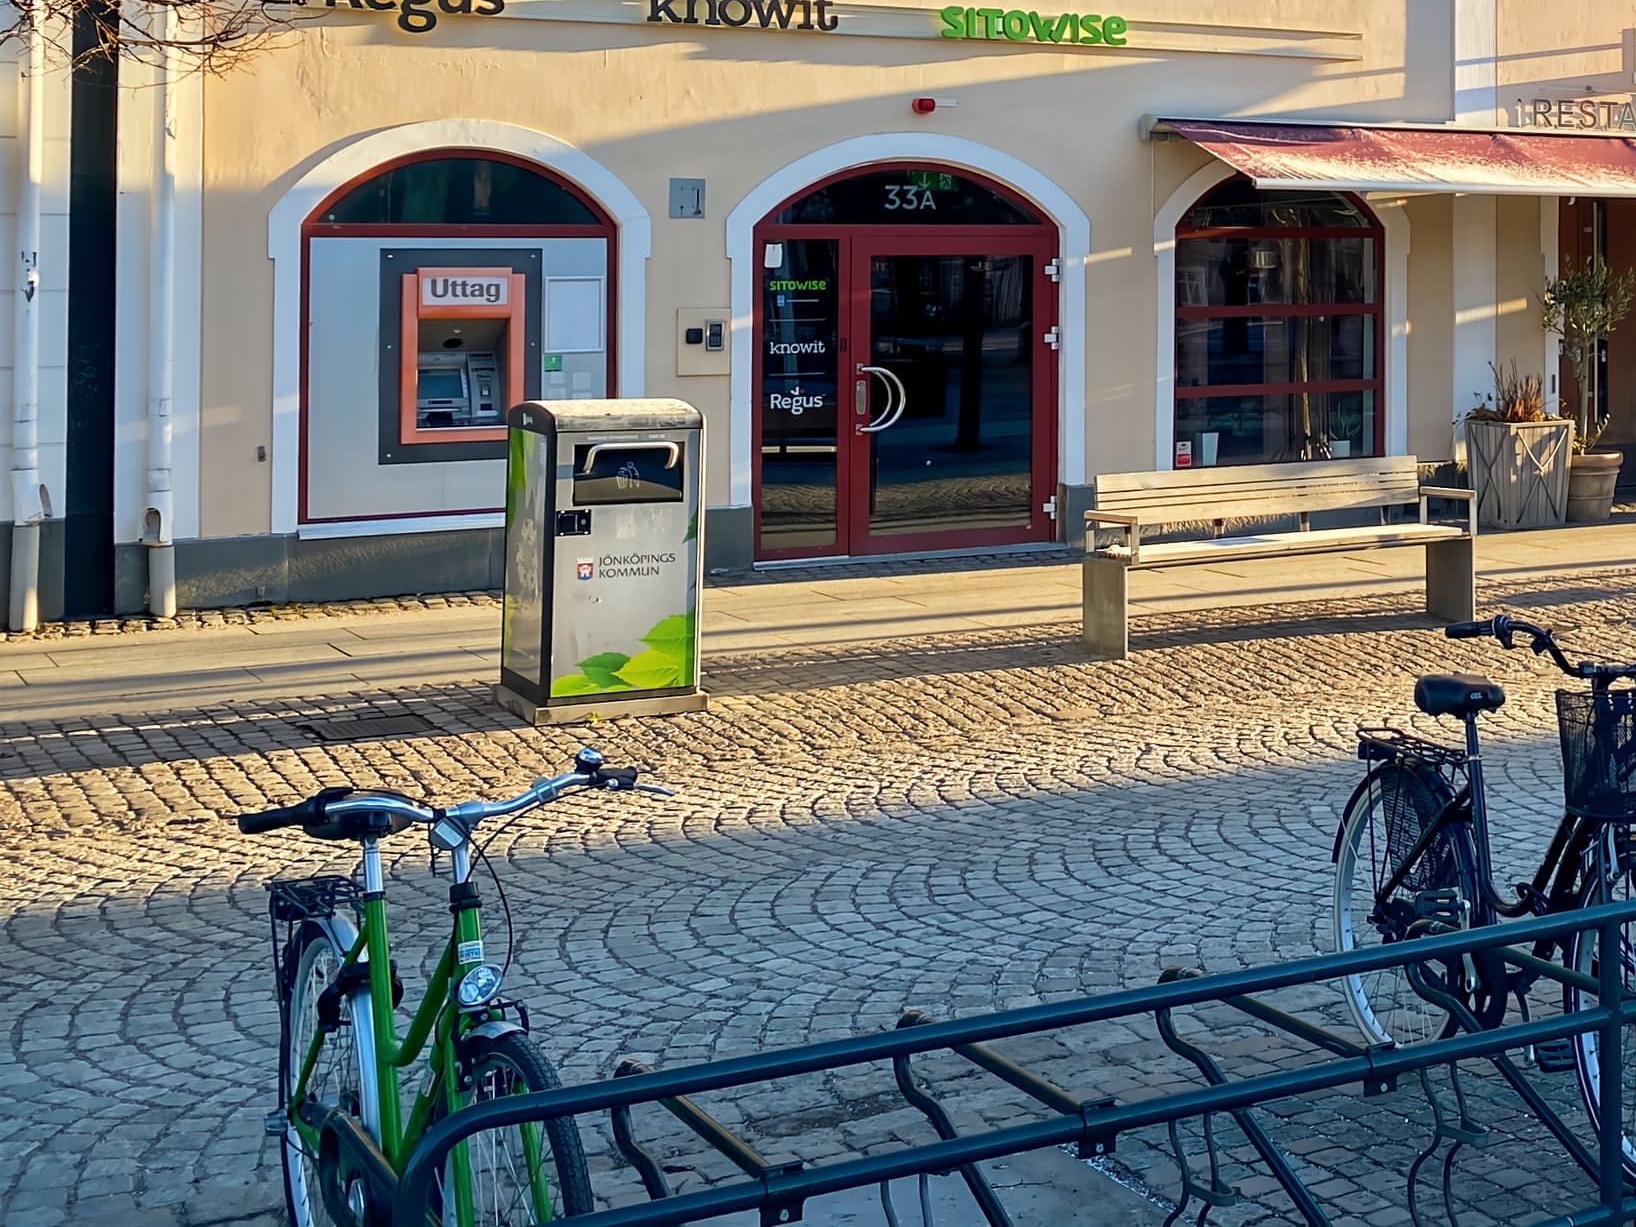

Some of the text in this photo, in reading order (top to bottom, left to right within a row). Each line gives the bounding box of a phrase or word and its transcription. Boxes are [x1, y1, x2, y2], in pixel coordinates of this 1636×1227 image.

[884, 185, 936, 210] 33A
[431, 278, 501, 302] Uttag
[769, 341, 826, 354] knowit
[769, 386, 824, 415] Regus
[599, 553, 676, 567] JÖNKÖPINGS
[599, 566, 660, 579] KOMMUN
